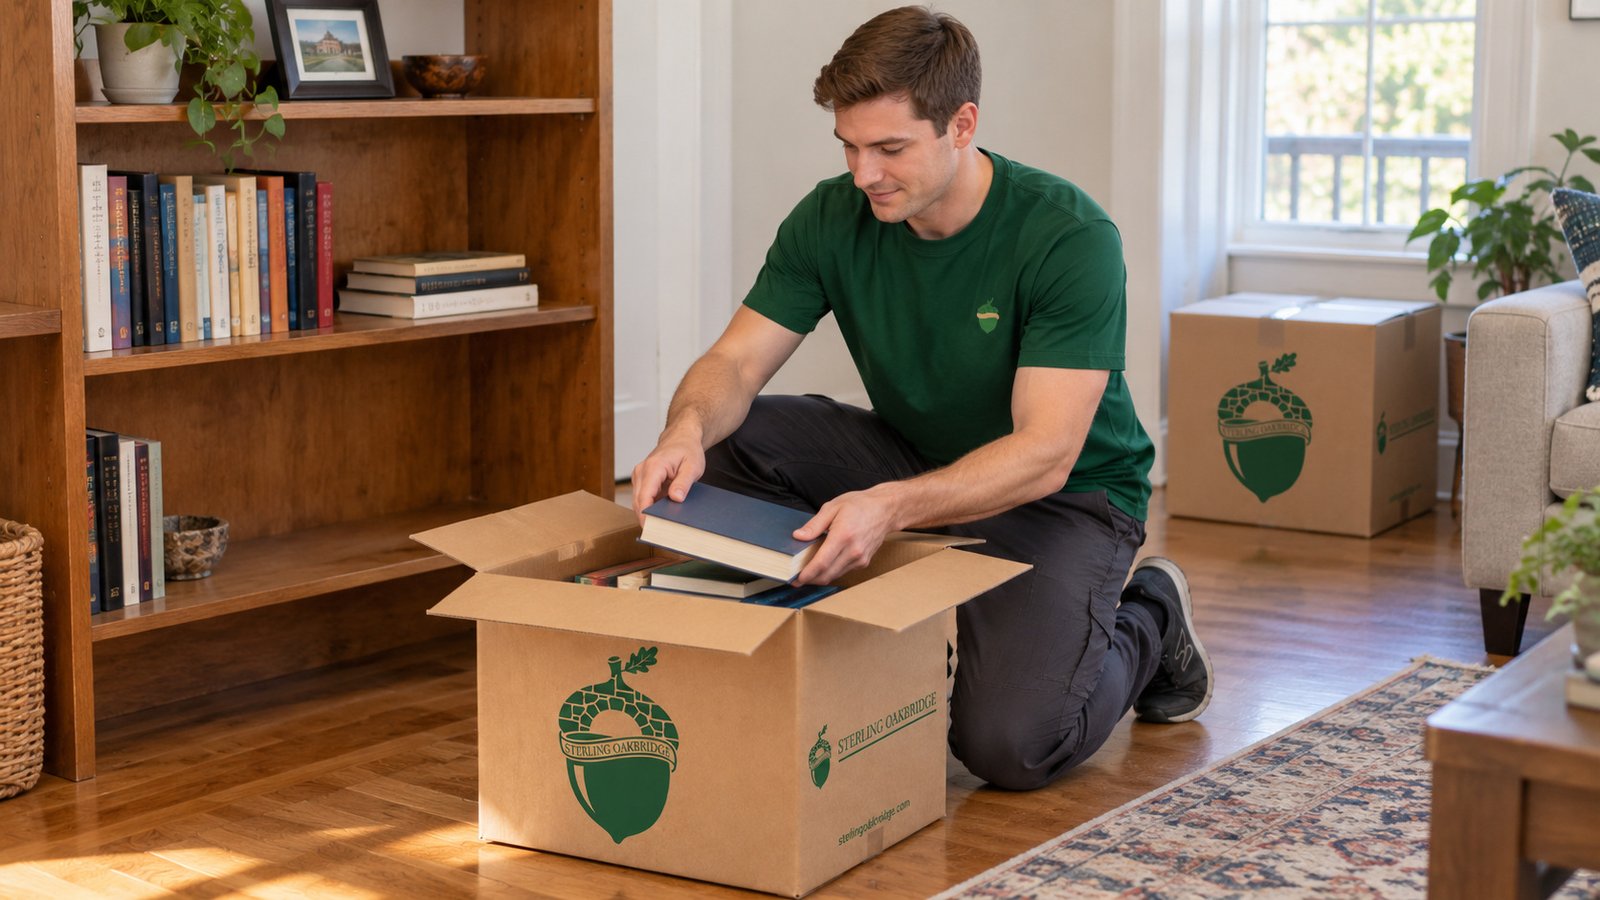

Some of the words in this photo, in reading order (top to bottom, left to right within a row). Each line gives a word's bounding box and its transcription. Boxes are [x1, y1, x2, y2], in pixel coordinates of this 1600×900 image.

[837, 719, 883, 755] STERLING
[885, 691, 937, 729] OAKBRIDGE
[564, 743, 610, 757] STERLING
[612, 741, 671, 758] OAKBRIDGE
